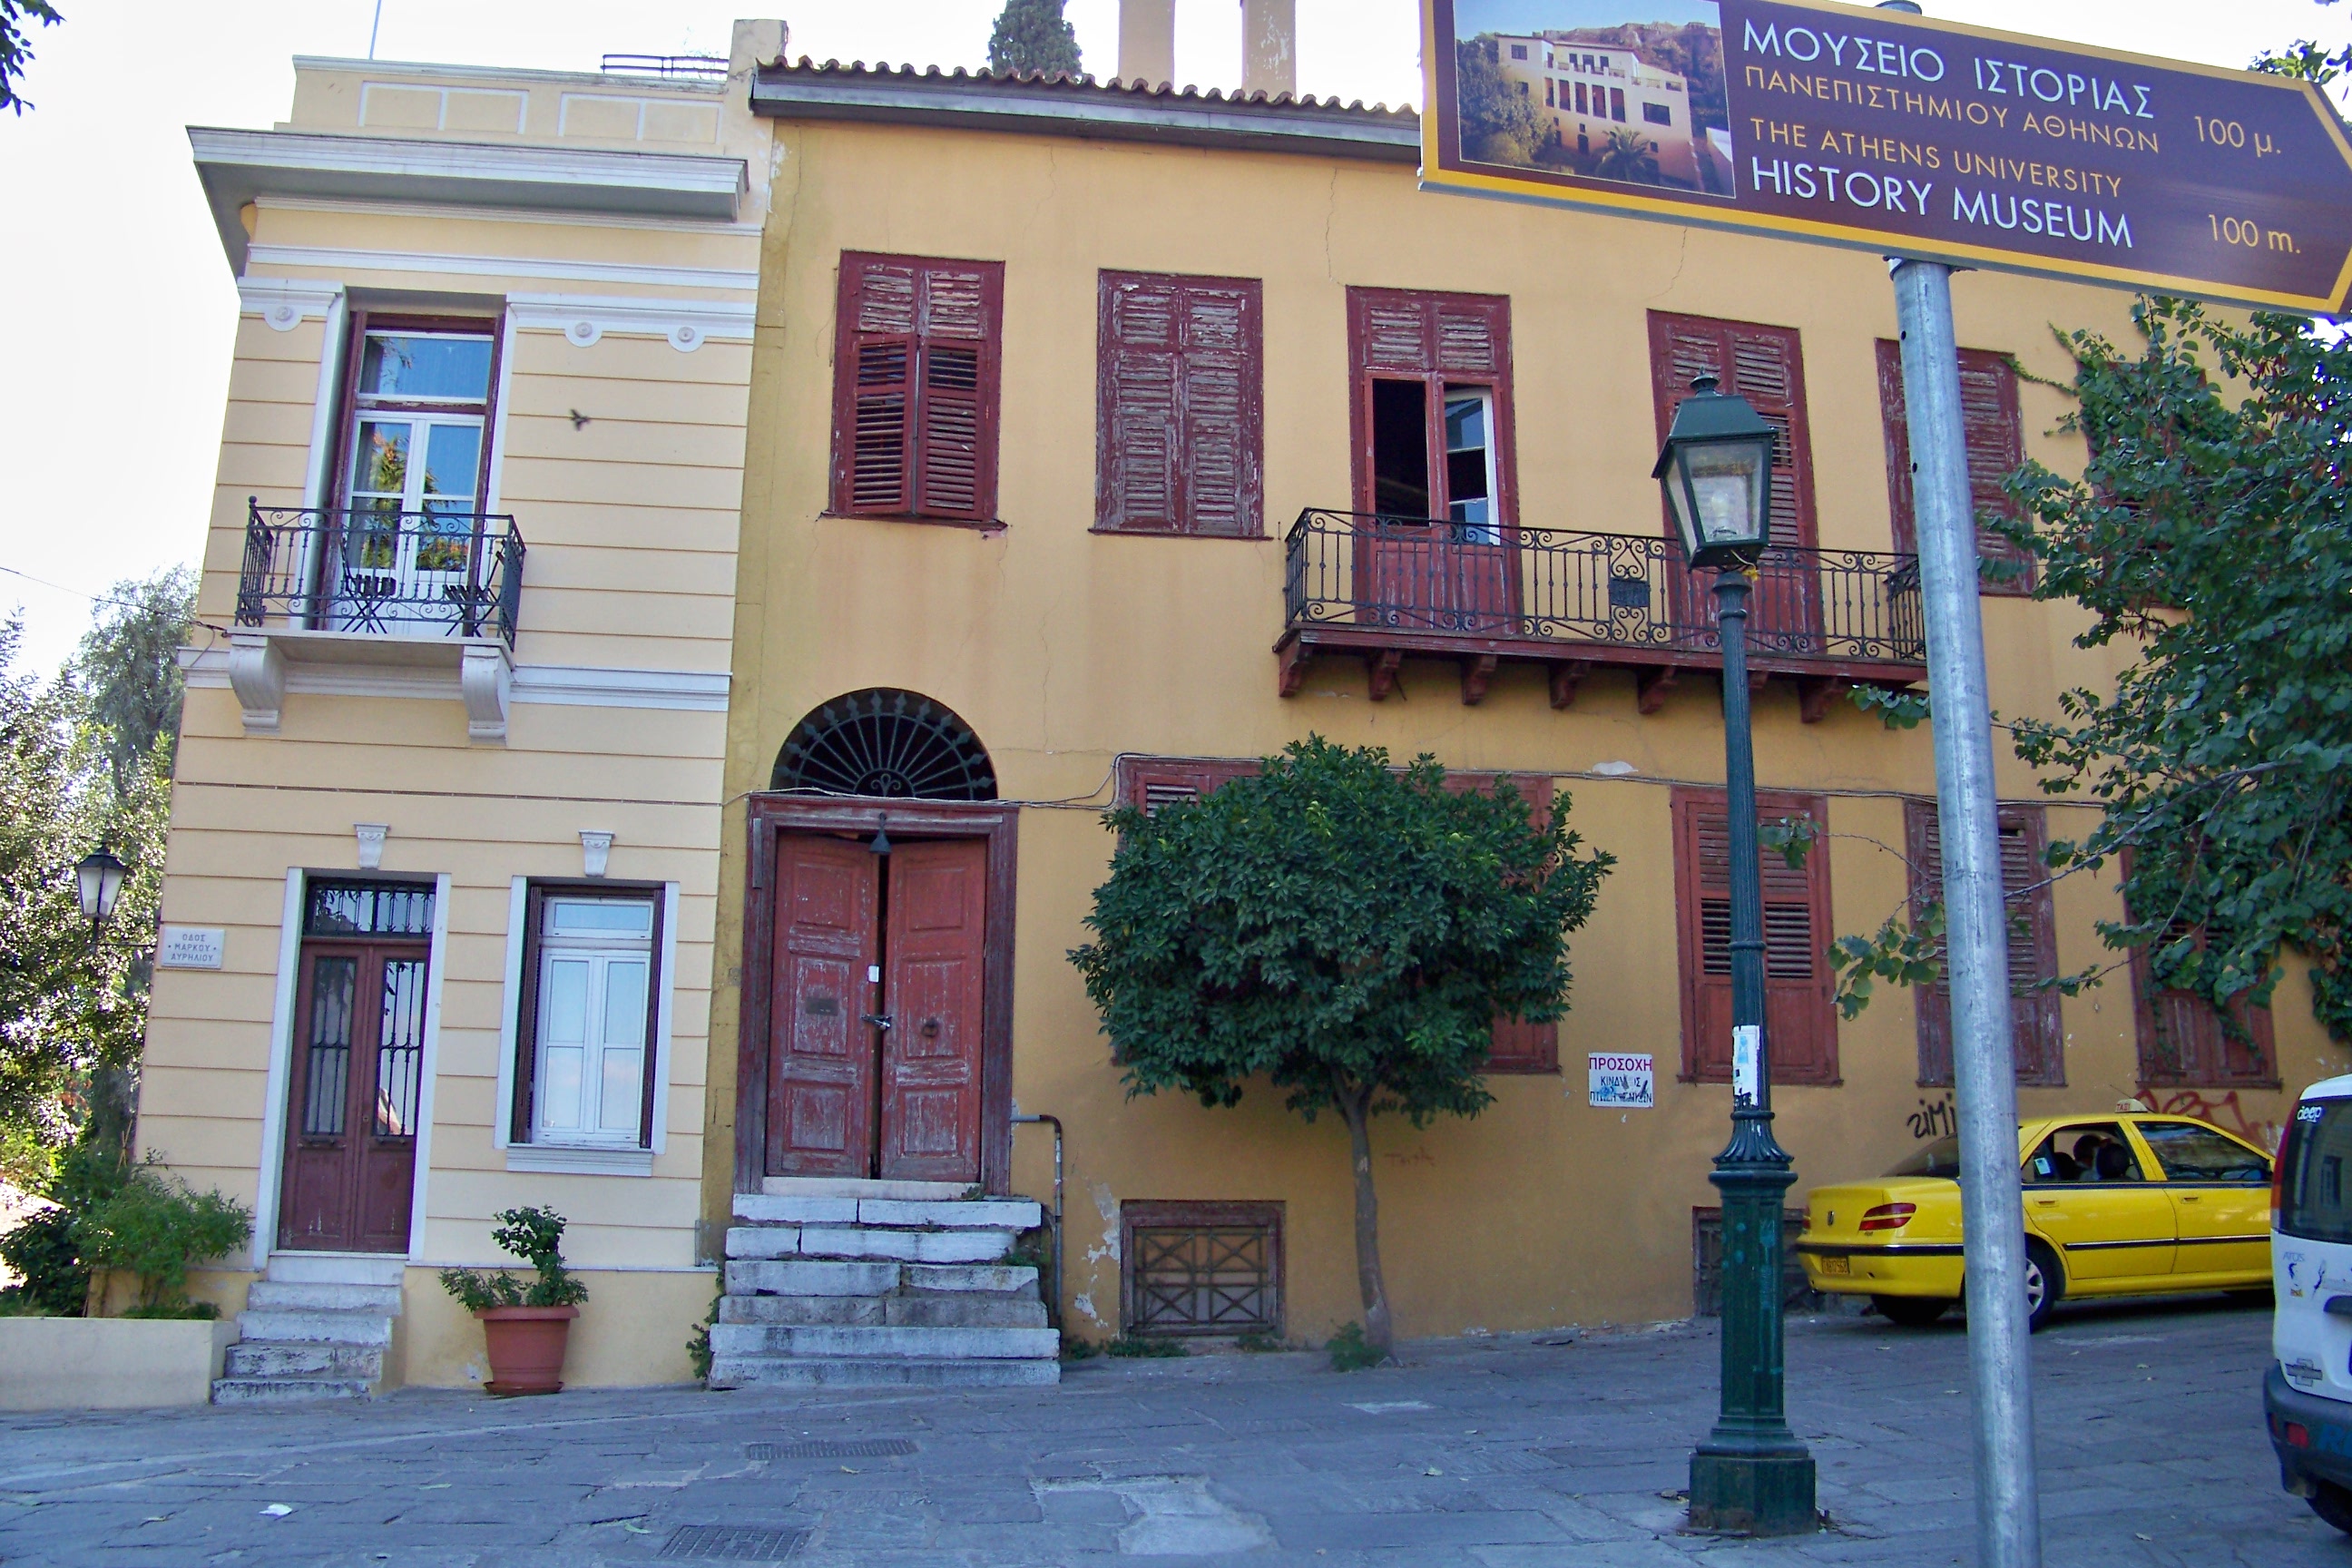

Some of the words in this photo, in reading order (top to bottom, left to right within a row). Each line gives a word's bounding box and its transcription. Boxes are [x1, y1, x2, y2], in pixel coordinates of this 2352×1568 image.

[1743, 18, 1945, 83] ΜΟΥΣΕΙΟ
[1974, 56, 2154, 119] ΙΣΤΟΡΙΑΣ
[1745, 65, 2008, 129] ΠΑΝΕΠΙΣΤΗΜΙΟΥ
[2023, 111, 2159, 153] ΑΘΗΝΩΝ
[1750, 117, 1807, 148] THE
[1820, 130, 1940, 169] ATHENS
[1954, 150, 2122, 198] UNIVERSITY
[2194, 115, 2245, 146] 100
[2254, 131, 2282, 158] μ.
[1751, 156, 1932, 216] HISTORY
[1953, 186, 2132, 249] MUSEUM
[2208, 213, 2259, 248] 100
[2268, 230, 2301, 254] m.
[171, 953, 213, 962] ΑΥΡΗΛΙΟΥ
[174, 943, 211, 952] ΜΑΡΚΟΥ
[182, 933, 206, 942] ΟΔΟΣ
[1589, 1057, 1652, 1072] ΠΡΟΣΟΧΗ
